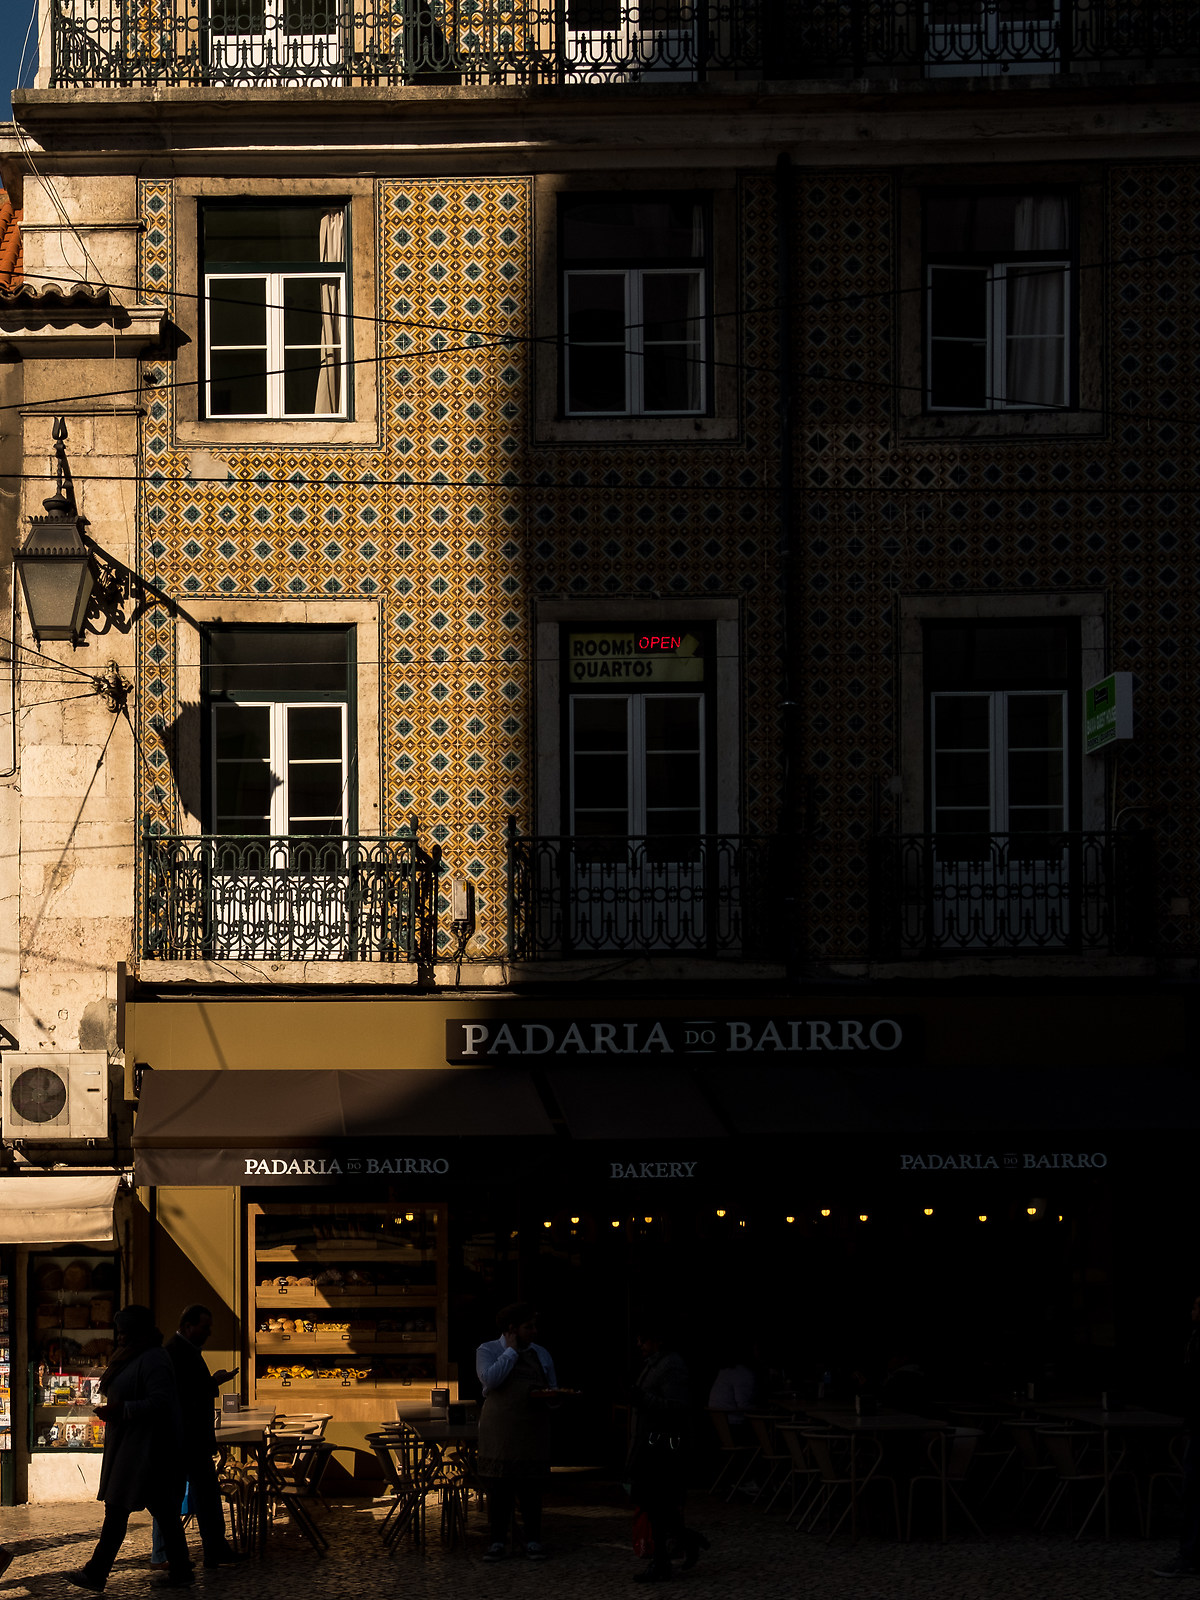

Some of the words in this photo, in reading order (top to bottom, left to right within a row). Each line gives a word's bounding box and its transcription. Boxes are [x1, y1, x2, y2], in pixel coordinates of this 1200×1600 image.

[573, 639, 633, 656] ROOMS
[638, 636, 682, 650] OPEN
[573, 660, 653, 680] QUARTOS
[460, 1021, 675, 1055] PADARIA
[684, 1029, 716, 1045] DO
[725, 1018, 903, 1052] BAIRRO
[244, 1158, 344, 1175] PADARIA
[347, 1162, 362, 1171] DO
[366, 1157, 450, 1175] BAIRRO
[609, 1160, 698, 1180] BAKERY
[900, 1153, 1000, 1170] PADARIA
[1003, 1156, 1018, 1165] DO
[1022, 1152, 1108, 1169] BAIRRO
